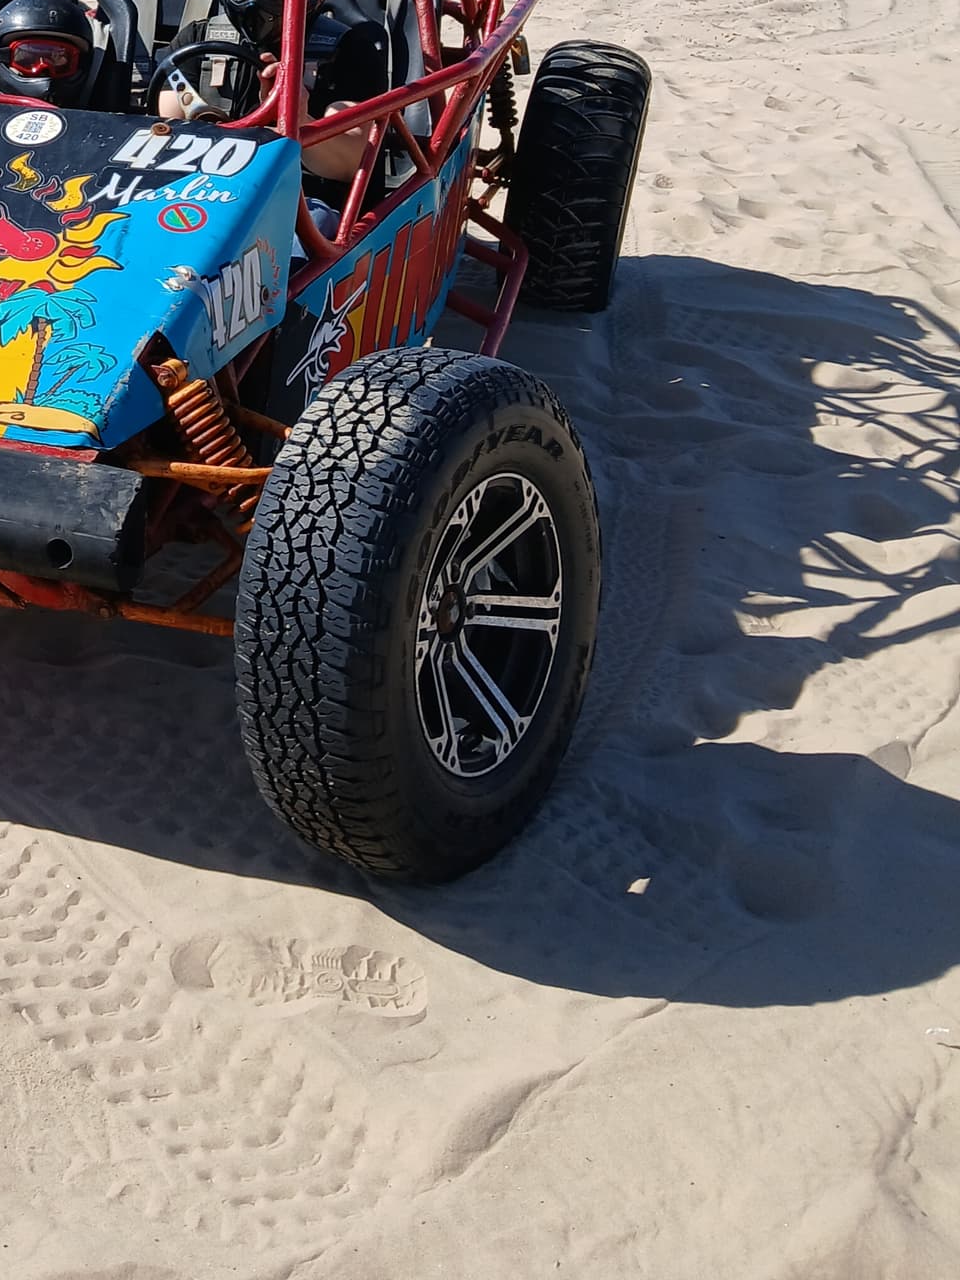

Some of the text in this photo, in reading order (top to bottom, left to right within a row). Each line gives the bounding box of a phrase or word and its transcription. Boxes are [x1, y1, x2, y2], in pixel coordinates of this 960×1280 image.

[15, 132, 40, 141] 420
[110, 128, 257, 177] 420
[87, 172, 237, 207] Marlin
